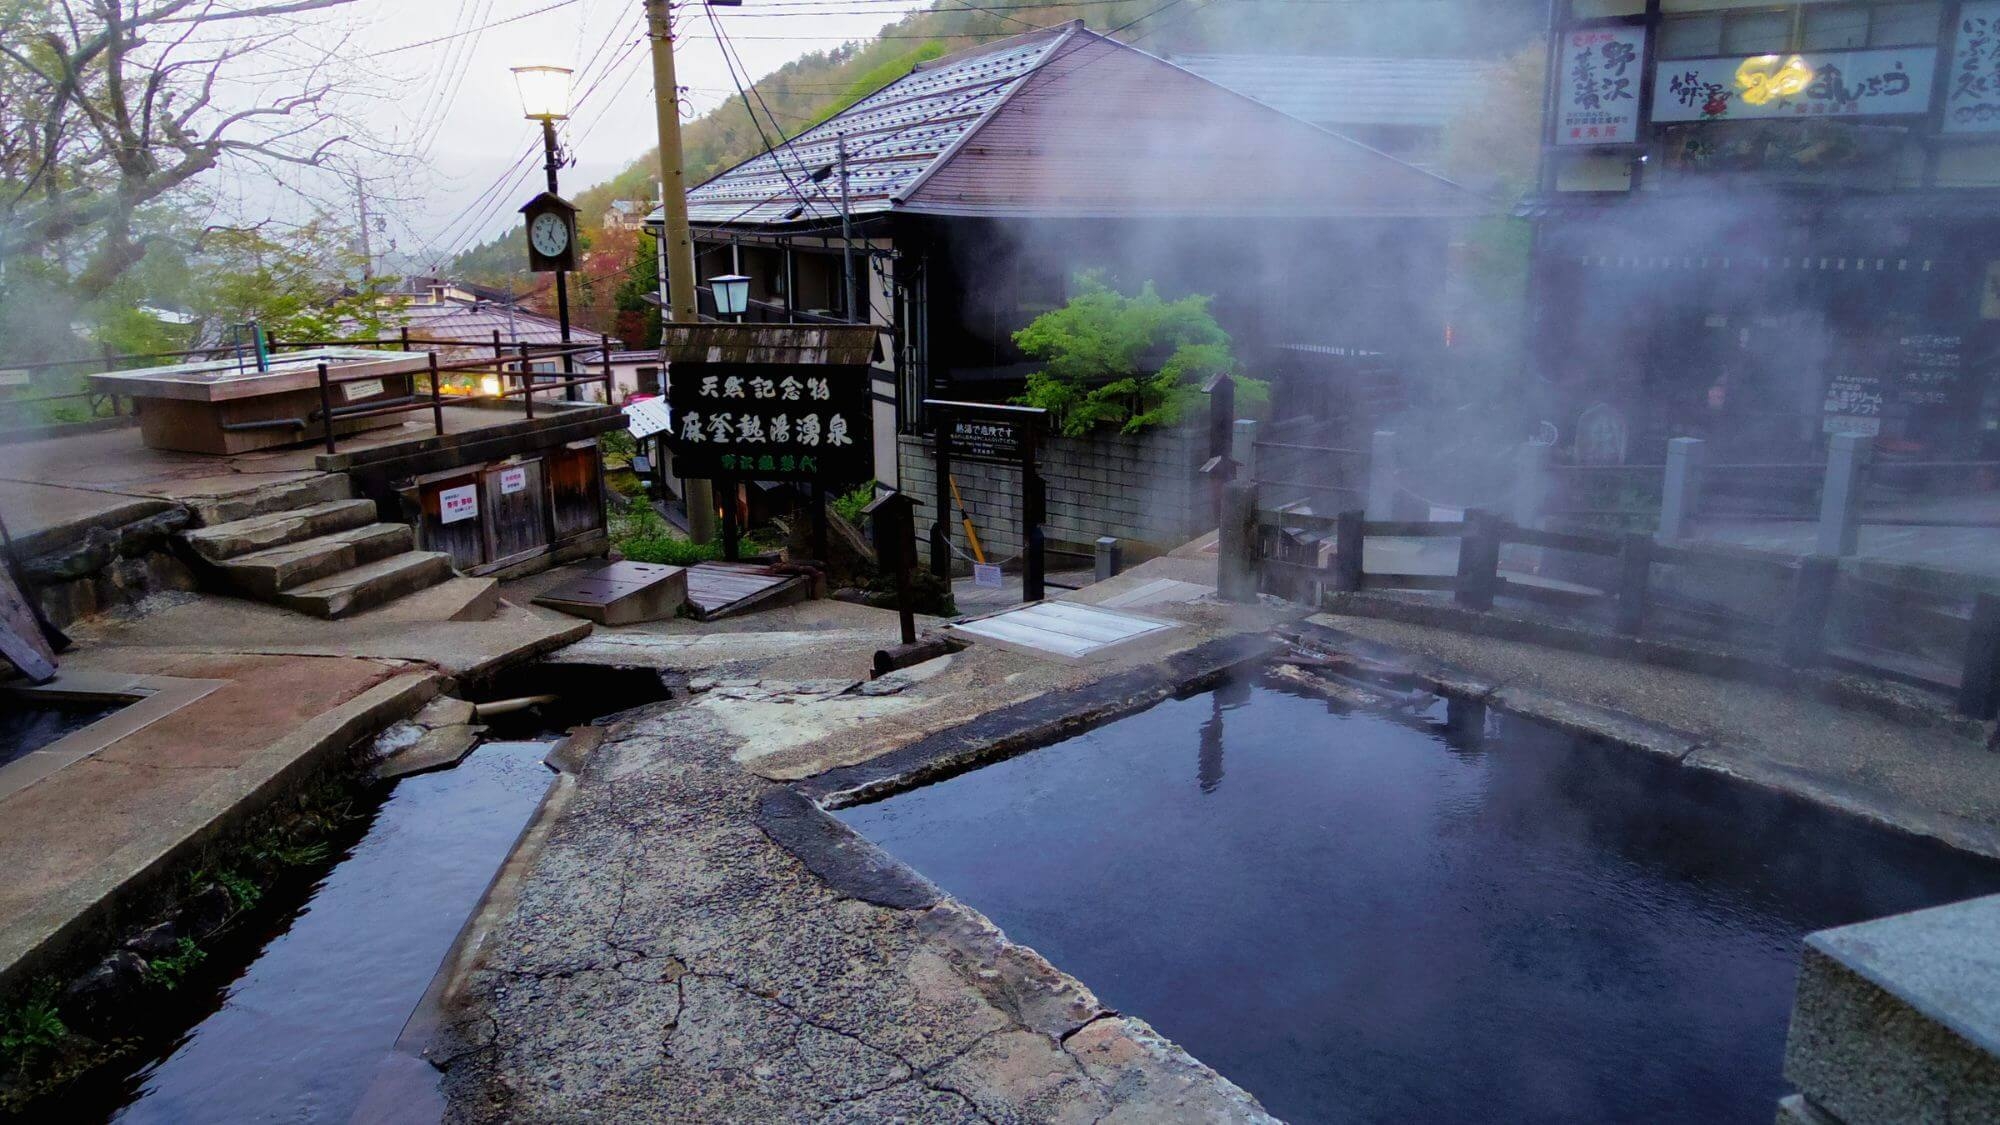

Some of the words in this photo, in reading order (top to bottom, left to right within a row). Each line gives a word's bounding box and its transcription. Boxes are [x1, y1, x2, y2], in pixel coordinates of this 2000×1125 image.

[1601, 41, 1636, 101] 野沢
[698, 375, 831, 401] 天然記念物
[680, 410, 853, 447] 麻釜熱湯湧泉
